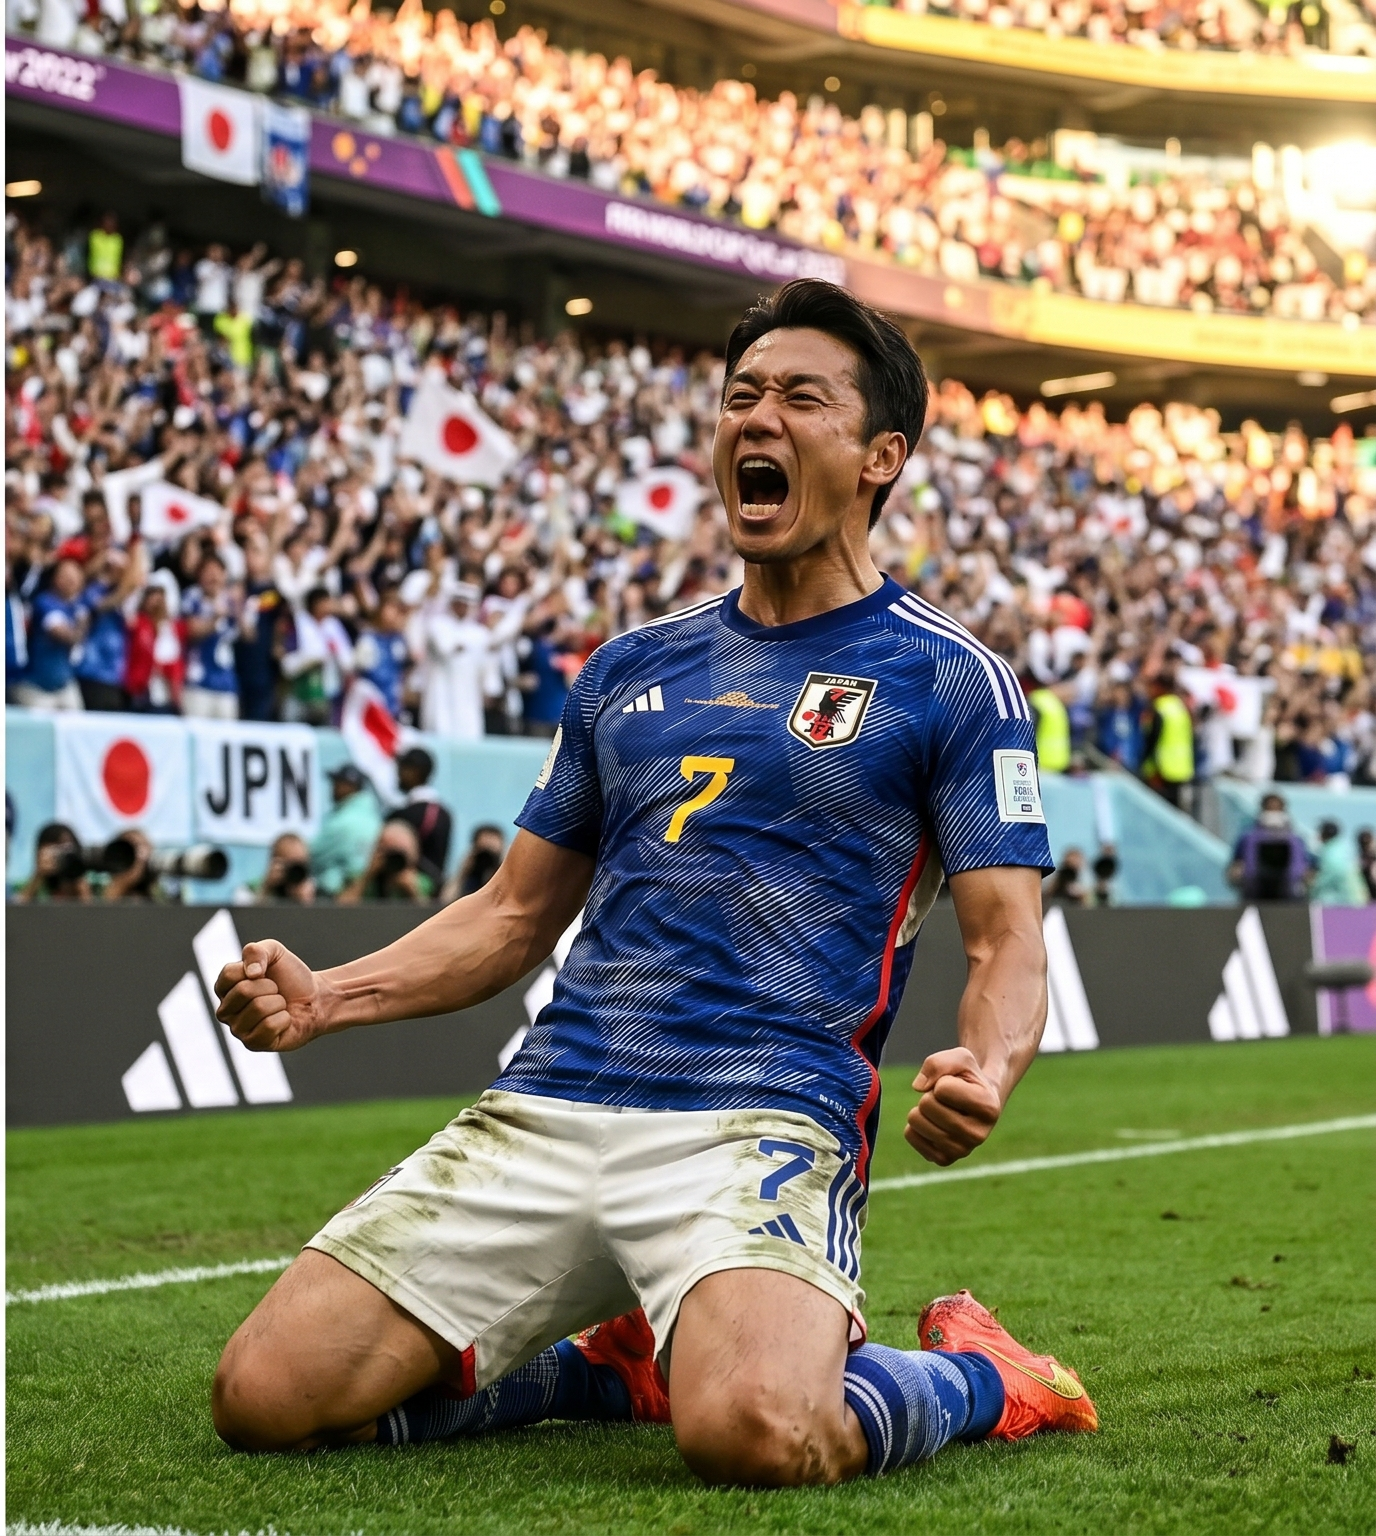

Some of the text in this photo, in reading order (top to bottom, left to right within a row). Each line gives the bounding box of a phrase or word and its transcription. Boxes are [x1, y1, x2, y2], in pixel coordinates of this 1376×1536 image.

[824, 677, 858, 687] JAPAN
[804, 722, 834, 739] JFA
[206, 740, 310, 818] JPN
[664, 755, 735, 843] 7
[758, 1139, 816, 1201] 7
